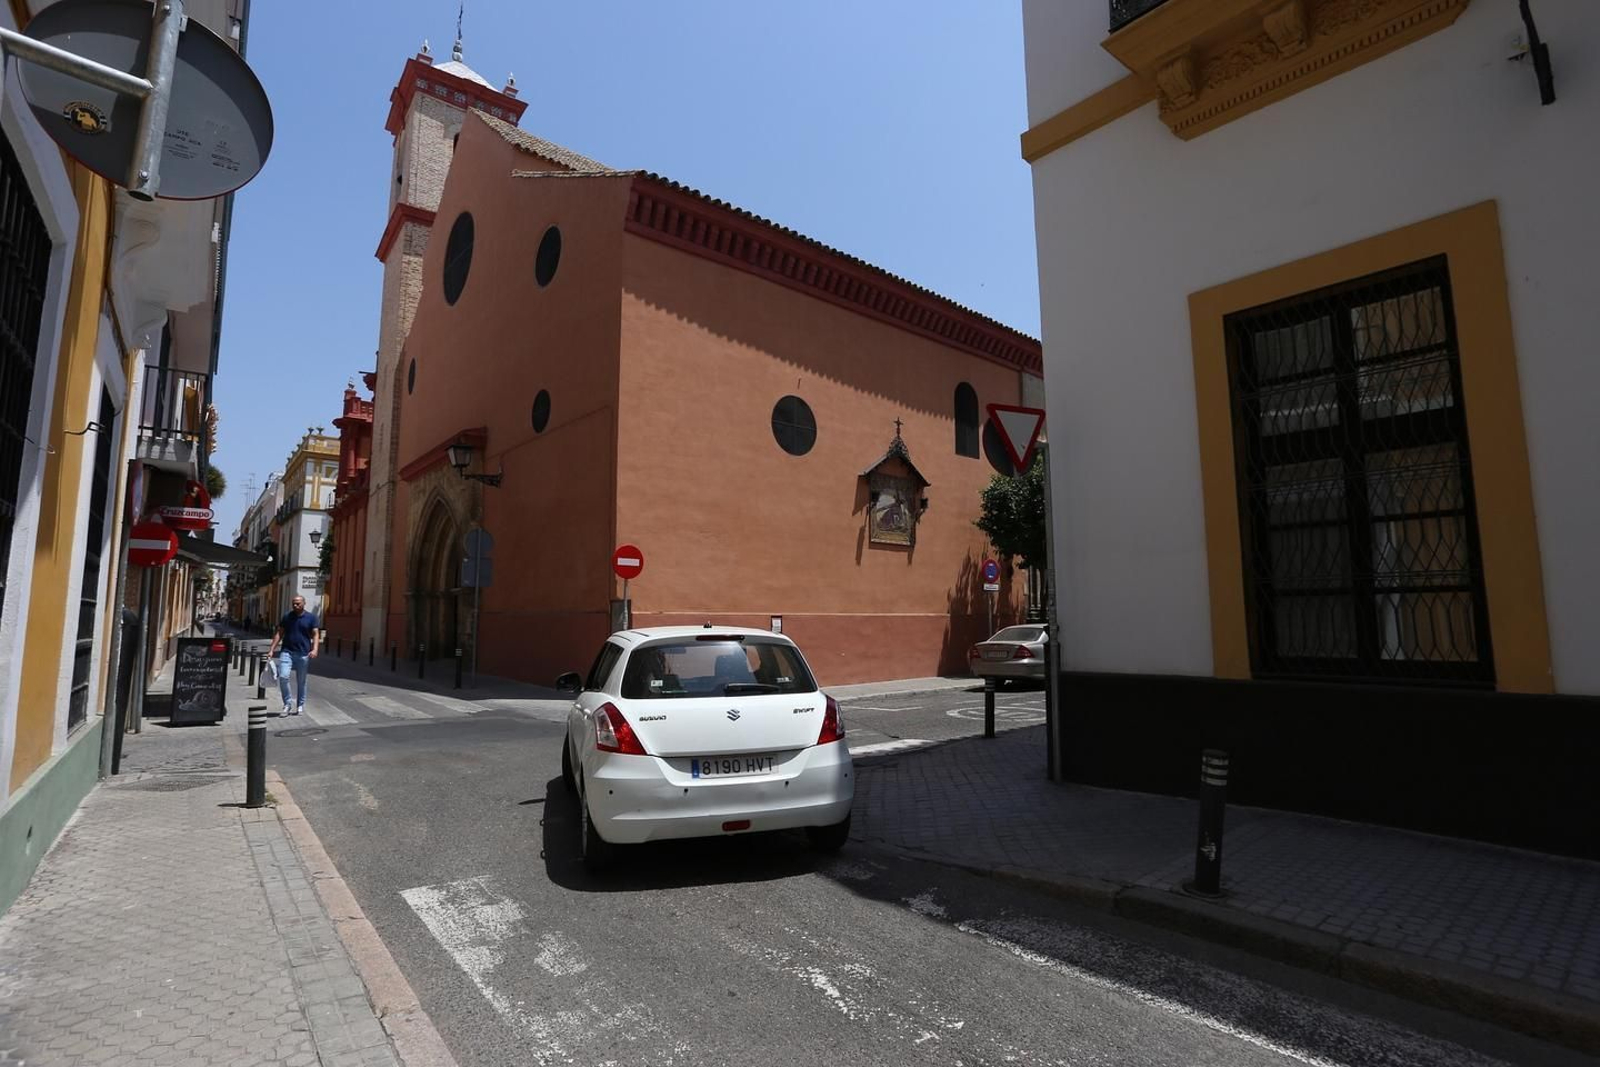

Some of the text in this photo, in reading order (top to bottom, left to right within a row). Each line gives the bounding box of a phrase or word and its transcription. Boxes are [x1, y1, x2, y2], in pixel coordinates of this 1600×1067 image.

[160, 507, 210, 518] Cruzcampo
[702, 757, 774, 776] 8190 HVT
